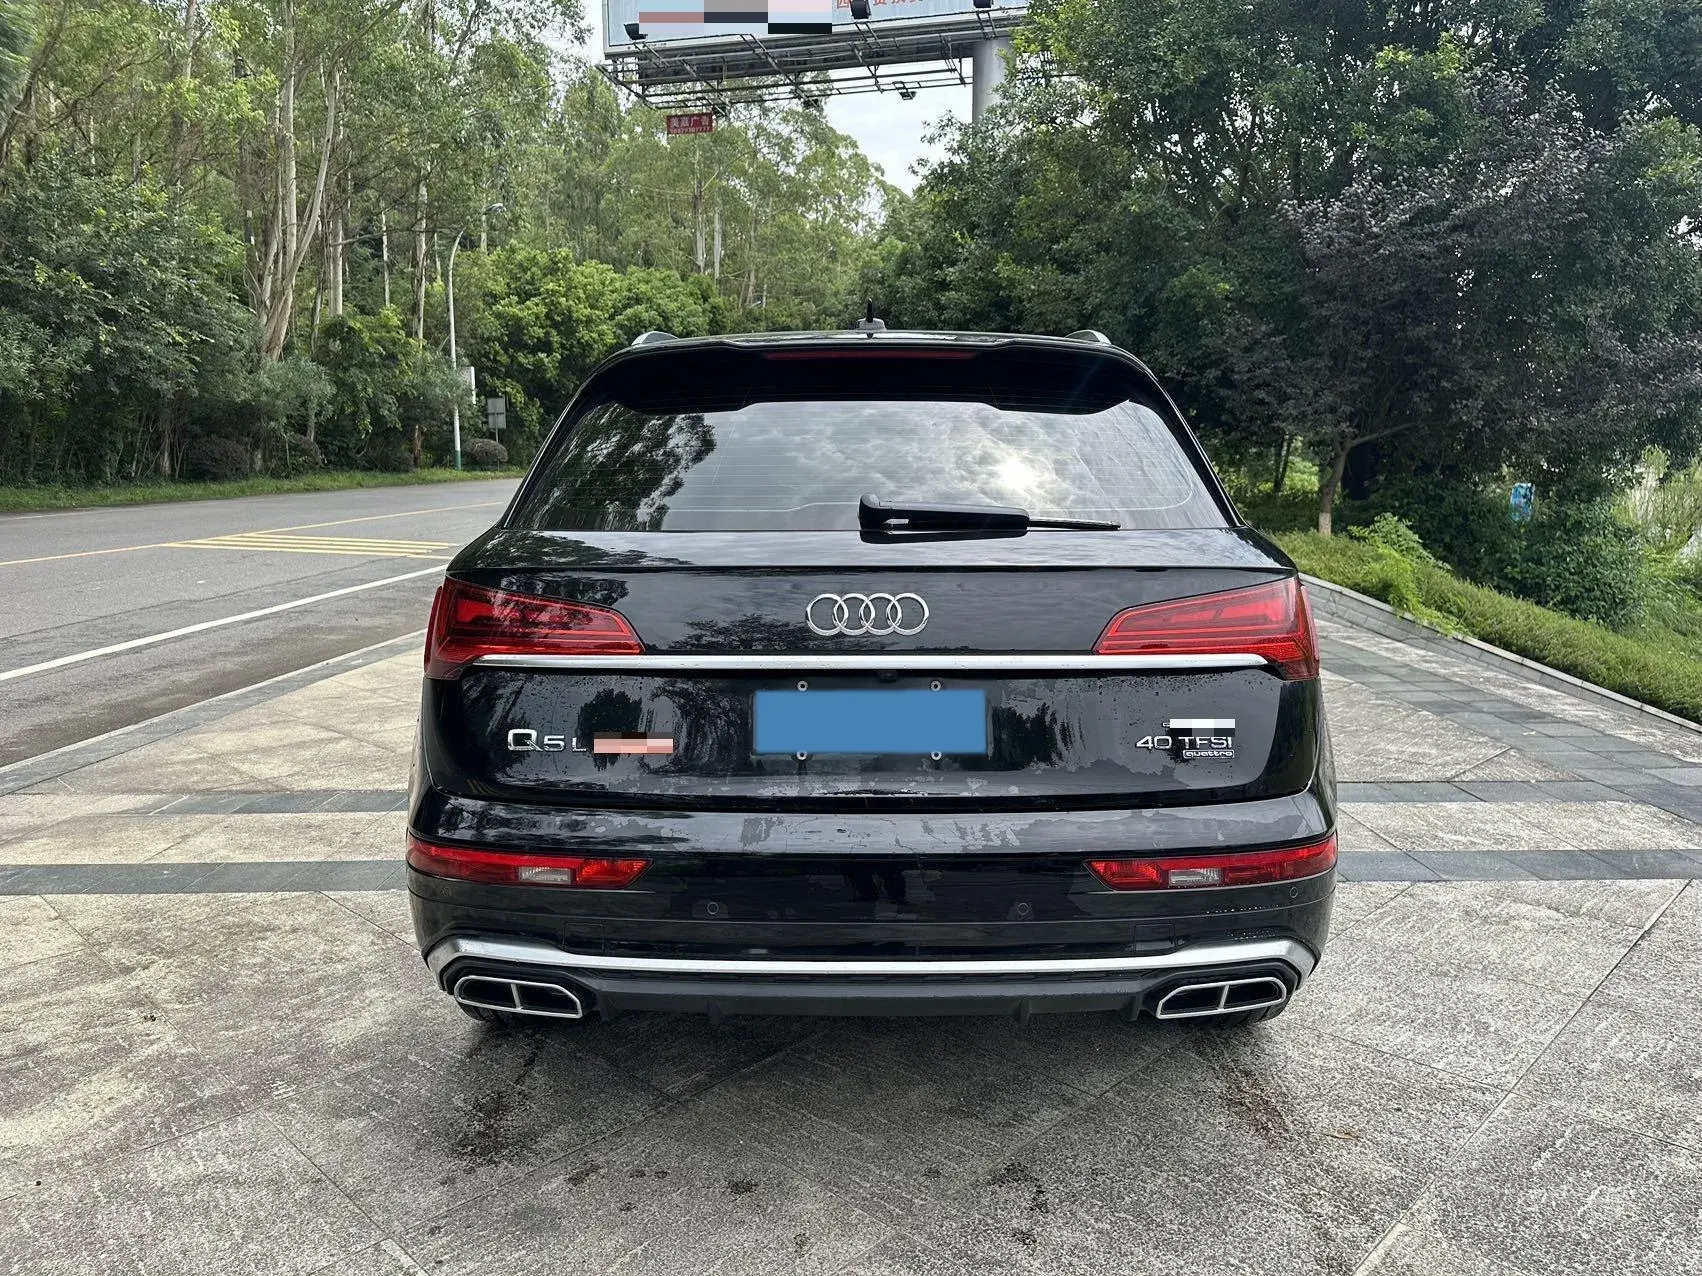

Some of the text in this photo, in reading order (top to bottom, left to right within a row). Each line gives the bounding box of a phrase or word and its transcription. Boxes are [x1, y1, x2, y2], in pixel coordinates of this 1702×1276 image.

[1135, 735, 1233, 750] 40 TFSI
[1184, 750, 1233, 758] quattro
